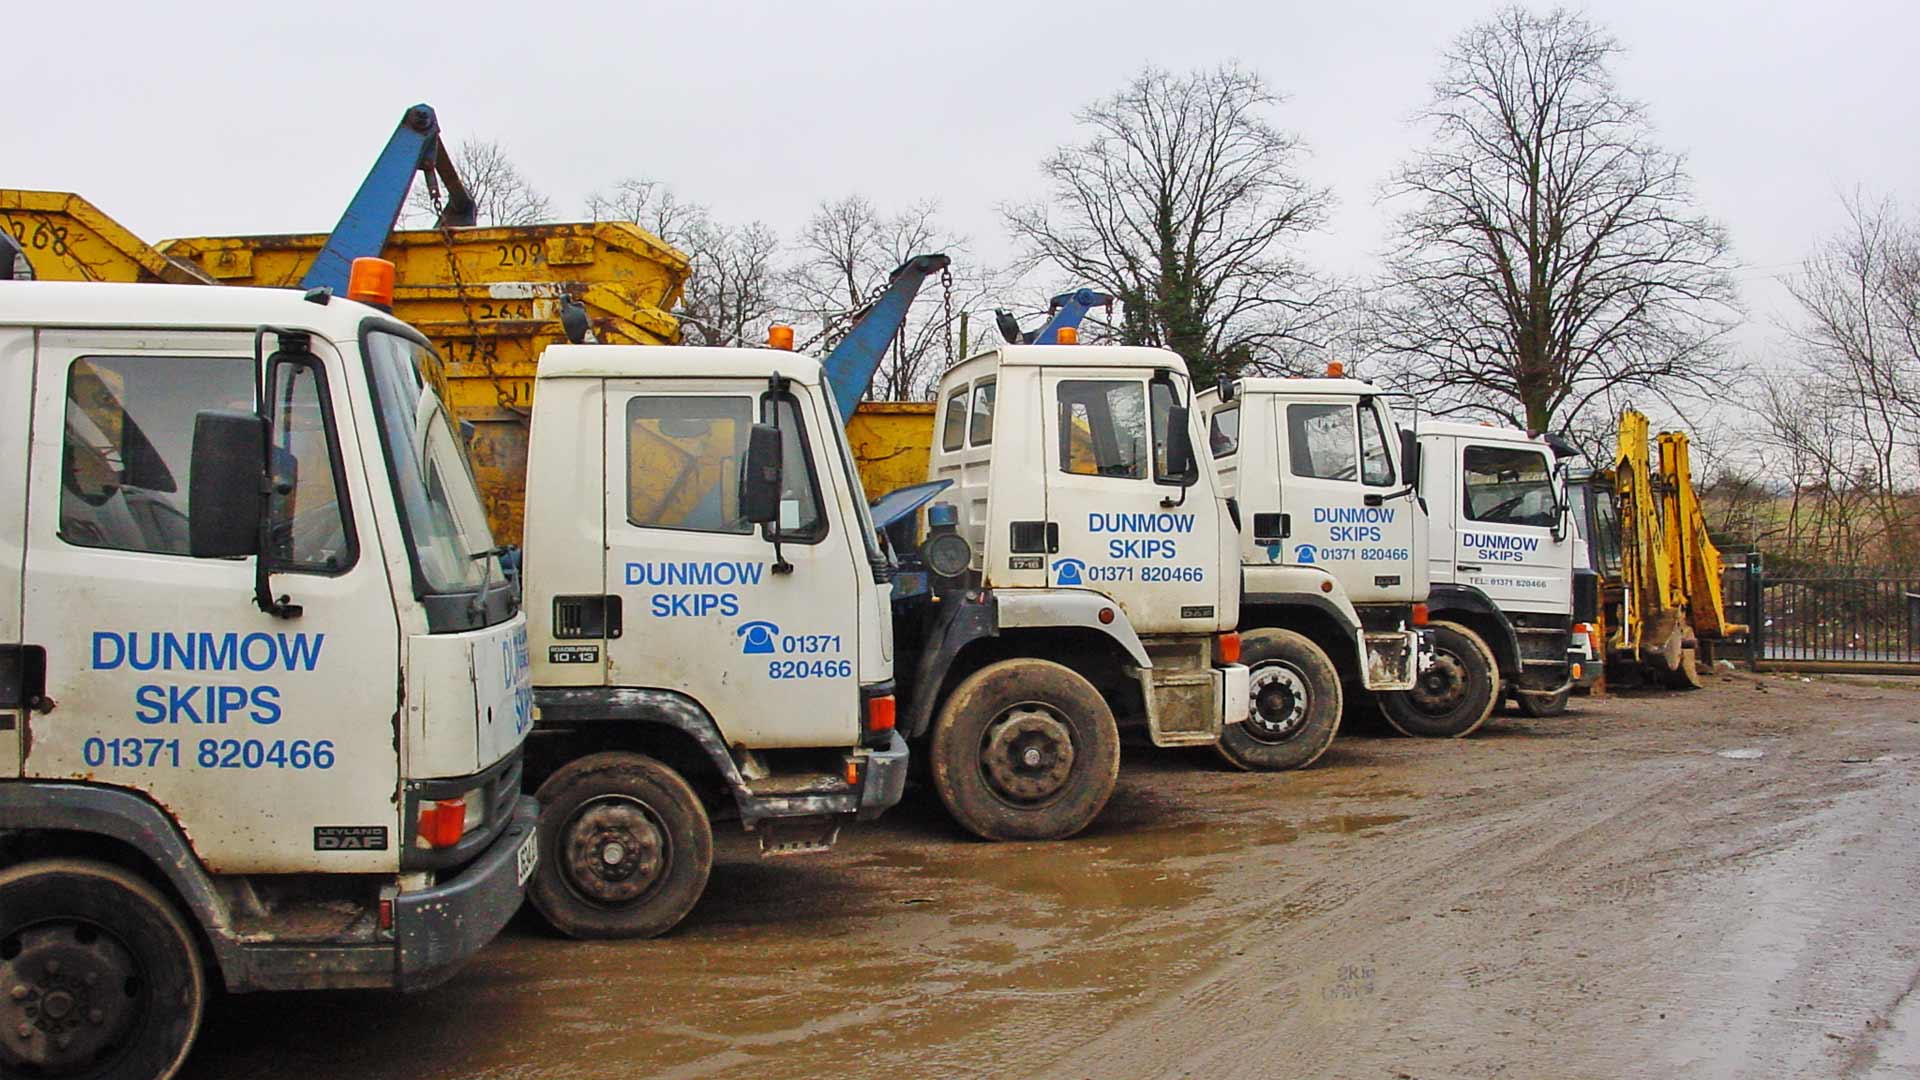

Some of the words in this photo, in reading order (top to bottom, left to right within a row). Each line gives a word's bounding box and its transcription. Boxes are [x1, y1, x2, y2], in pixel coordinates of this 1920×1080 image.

[12, 221, 69, 257] 268
[1088, 513, 1195, 533] DUNMOW
[1313, 507, 1394, 524] DUNMOW
[1330, 526, 1382, 542] SKIPS
[1462, 533, 1539, 552] DUNMOW
[1108, 539, 1176, 559] SKIPS
[1320, 547, 1357, 561] 01371
[1360, 547, 1409, 561] 820466
[1478, 548, 1525, 562] SKIPS
[624, 562, 764, 586] DUNMOW
[1088, 566, 1134, 582] 01371
[1141, 567, 1204, 583] 820466
[1490, 578, 1513, 587] 01371
[1516, 580, 1547, 588] 820466
[651, 593, 740, 617] SKIPS
[91, 631, 325, 672] DUNMOW
[782, 635, 841, 653] 01371
[768, 660, 852, 679] 820466
[135, 685, 281, 725] SKIPS
[82, 737, 180, 768] 01371
[197, 738, 335, 769] 820466
[318, 828, 384, 836] LEYLAND
[319, 836, 384, 849] DAF
